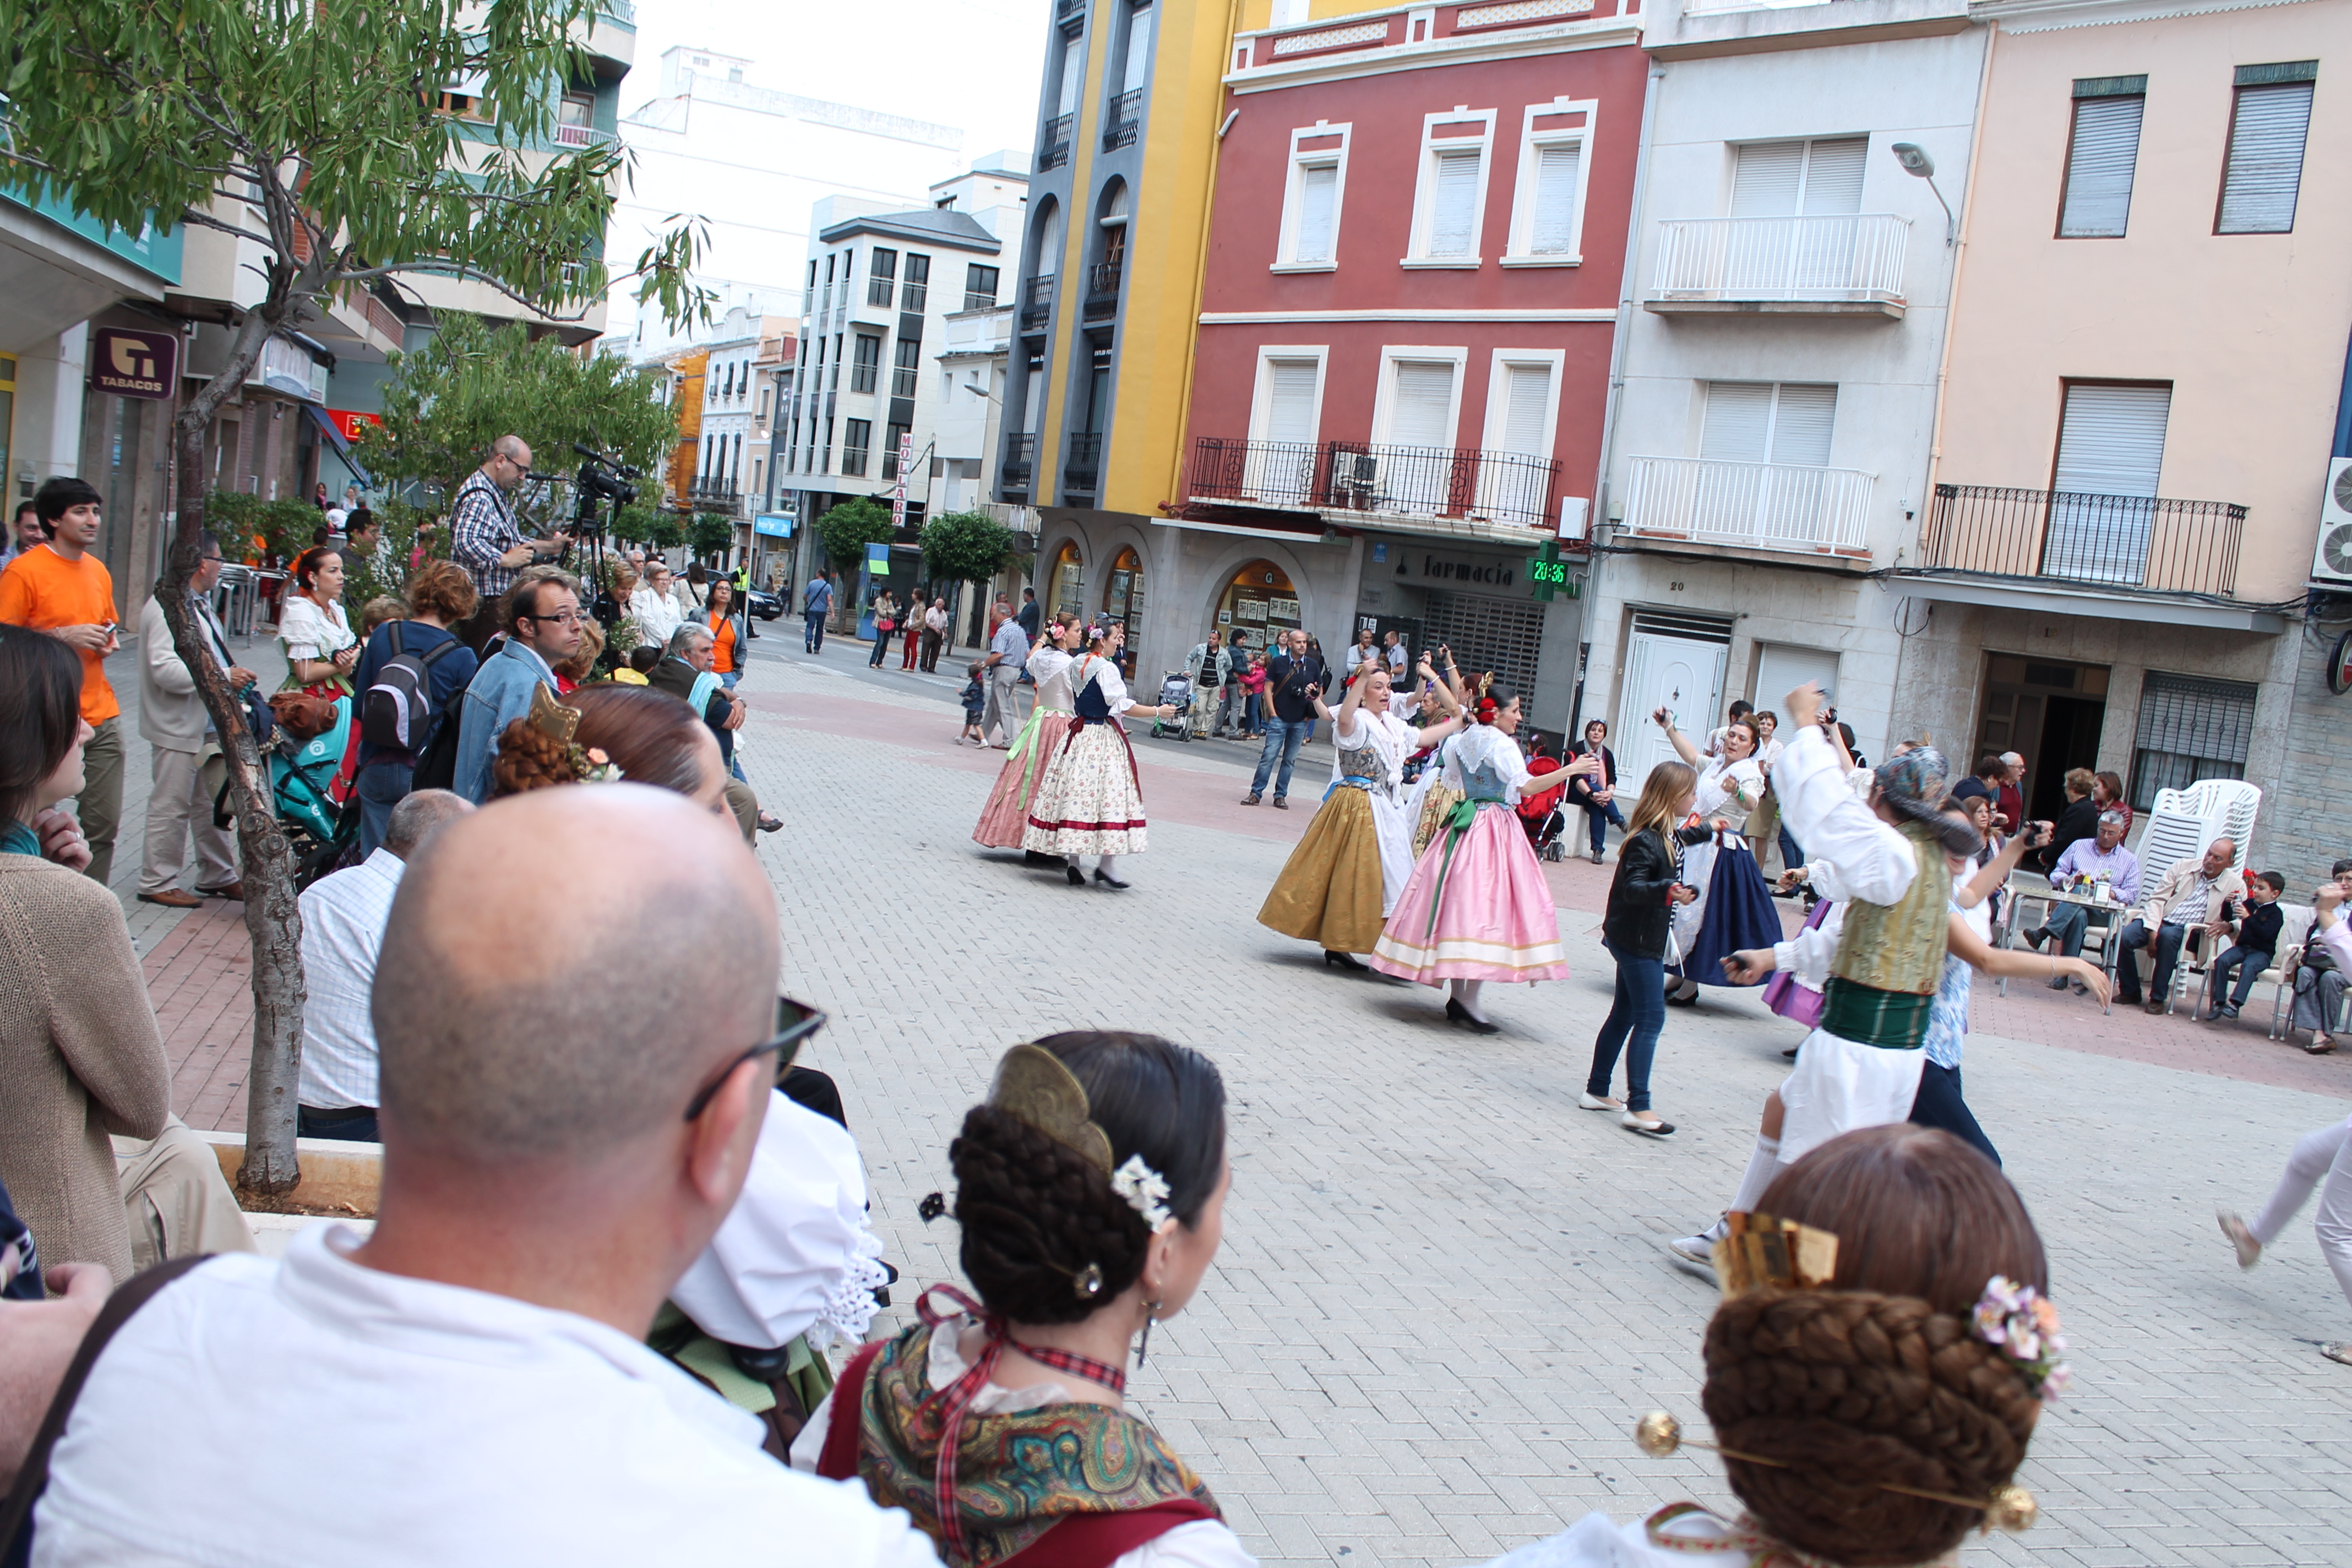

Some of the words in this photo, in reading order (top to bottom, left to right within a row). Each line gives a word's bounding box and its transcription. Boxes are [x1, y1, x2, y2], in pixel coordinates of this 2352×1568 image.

[100, 375, 163, 392] TABACOS
[893, 435, 911, 525] MOLLARO
[1424, 554, 1513, 586] farmacia
[1534, 560, 1565, 583] 20:36
[1670, 581, 1684, 591] 20
